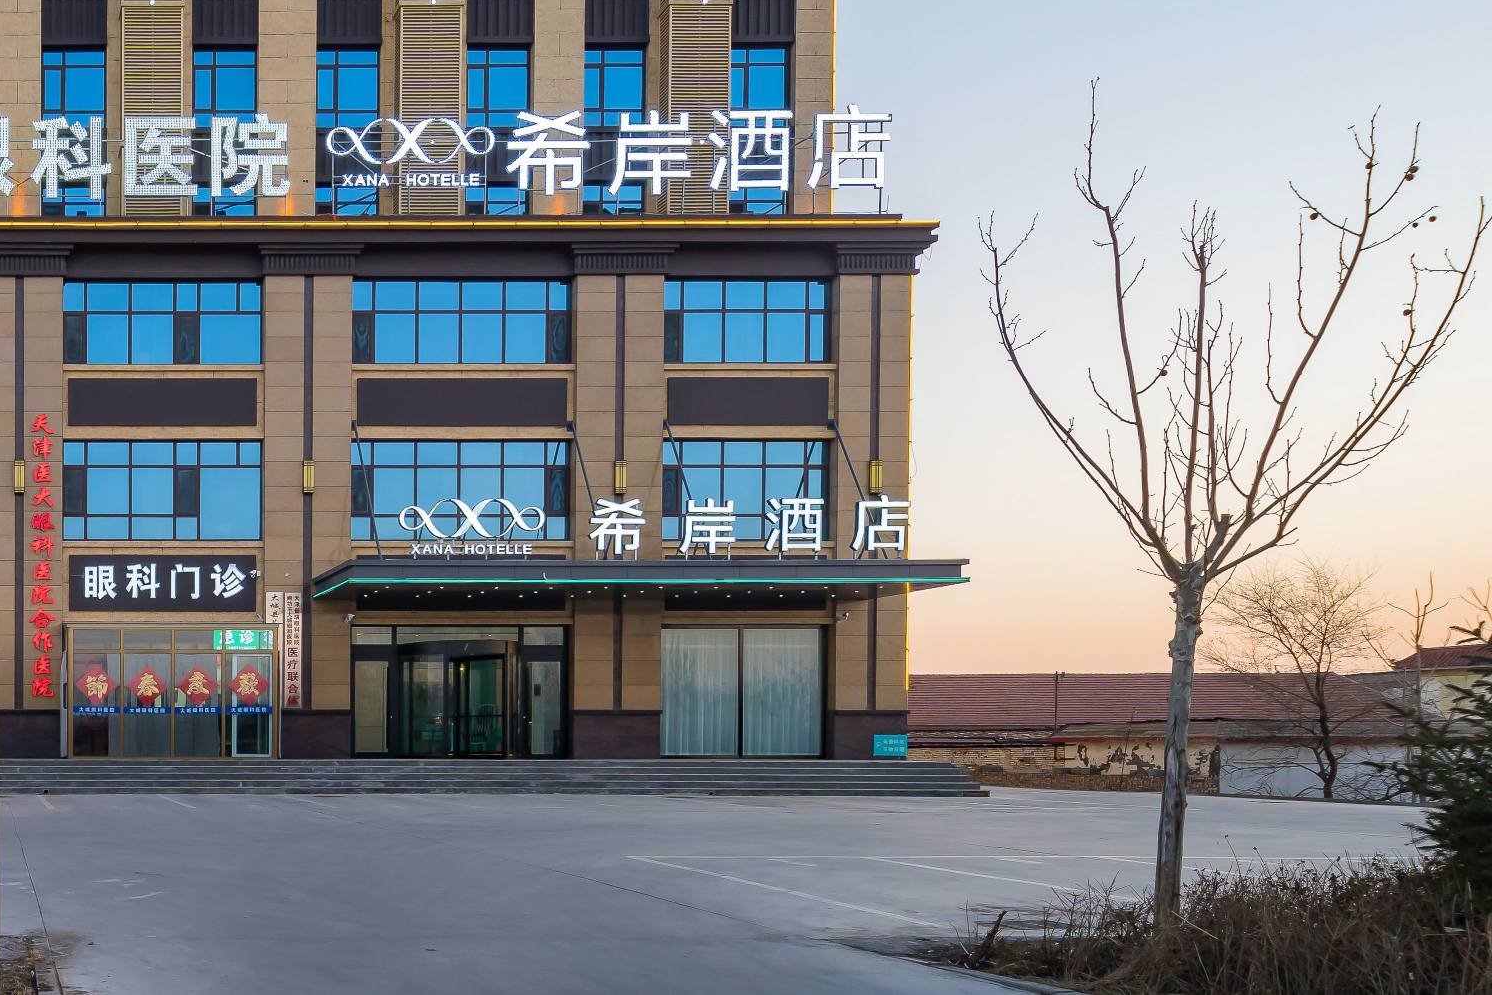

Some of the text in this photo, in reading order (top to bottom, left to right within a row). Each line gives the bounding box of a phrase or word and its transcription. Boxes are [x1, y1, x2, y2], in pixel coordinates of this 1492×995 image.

[506, 103, 892, 196] 希岸酒店
[342, 173, 480, 187] XANA HOTELLE
[411, 543, 533, 555] XANA HOTELLE
[589, 494, 911, 556] 希岸酒店
[29, 413, 56, 697] 天津医大眼科医院合作医院
[84, 563, 246, 600] 眼科门诊
[136, 672, 160, 697] 春
[287, 647, 300, 706] 医疗联合体
